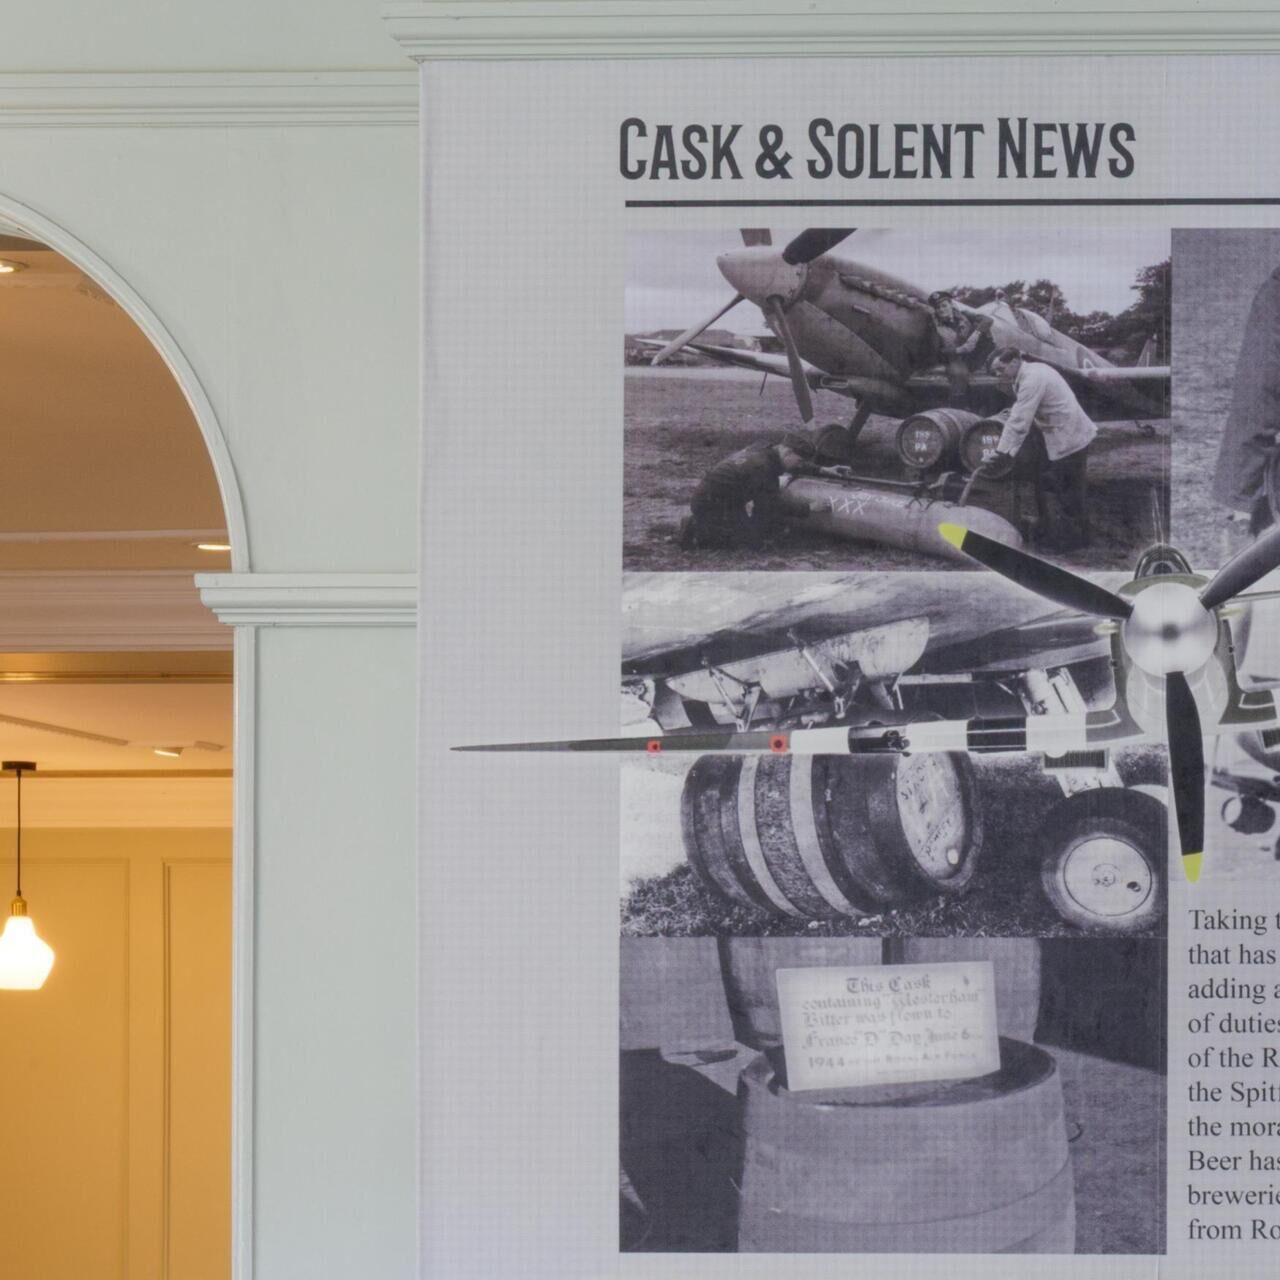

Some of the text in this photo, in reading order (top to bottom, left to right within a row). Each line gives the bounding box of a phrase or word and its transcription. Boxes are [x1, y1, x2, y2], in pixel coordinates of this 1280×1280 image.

[620, 118, 1136, 180] CASK & SOLENT NEWS
[1189, 909, 1267, 936] Taking
[1189, 944, 1230, 964] that
[1240, 944, 1276, 964] has
[1188, 978, 1266, 1004] adding
[1188, 1012, 1215, 1033] of
[1188, 1047, 1215, 1068] of
[1220, 1047, 1253, 1068] the
[1189, 1081, 1222, 1102] the
[1188, 1115, 1222, 1136] the
[1189, 1150, 1242, 1171] Beer
[1189, 1218, 1242, 1240] from
